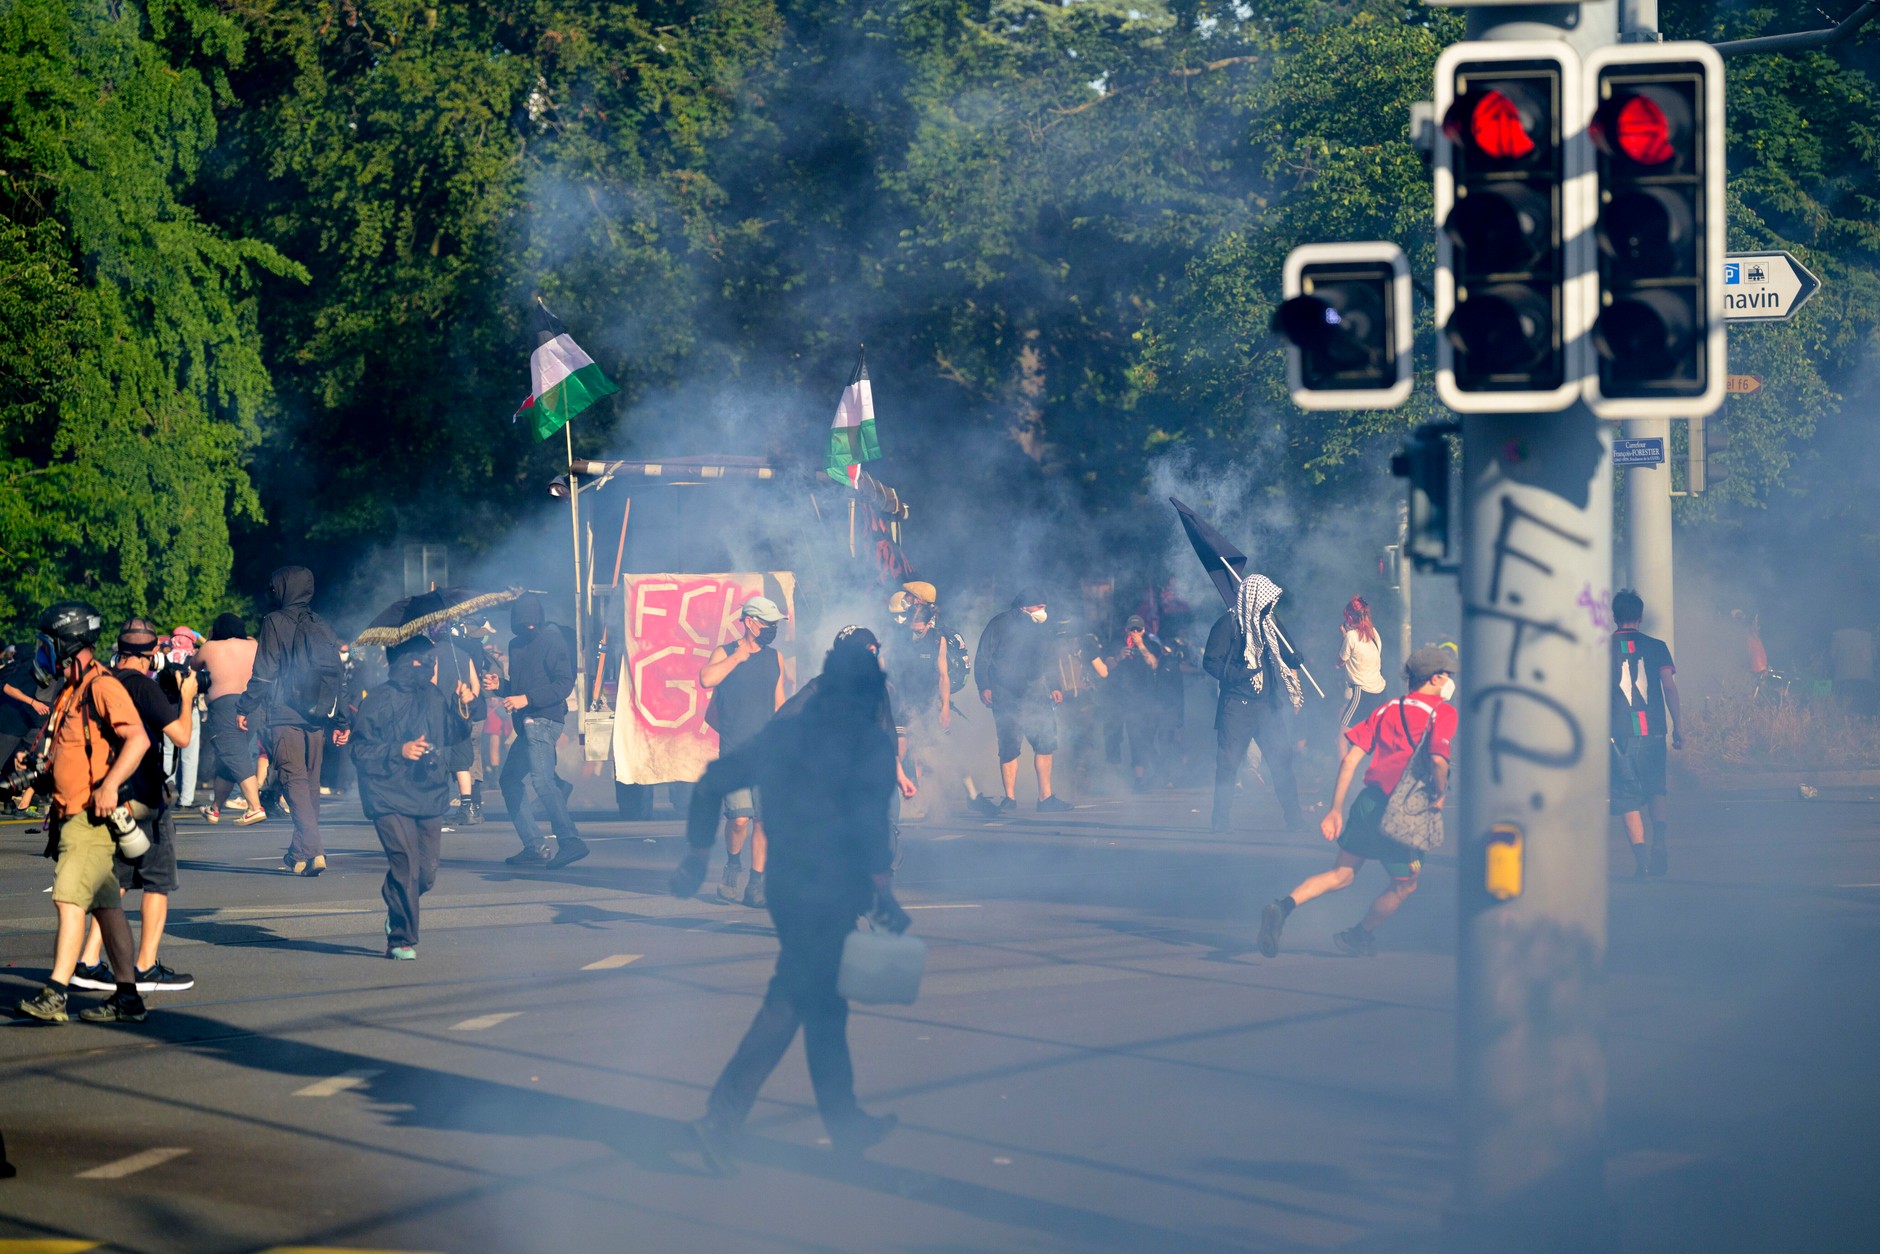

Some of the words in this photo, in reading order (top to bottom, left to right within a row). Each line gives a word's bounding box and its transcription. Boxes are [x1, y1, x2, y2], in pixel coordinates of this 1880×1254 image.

[1725, 269, 1734, 283] P
[1723, 287, 1779, 309] navin
[634, 583, 743, 648] FCK
